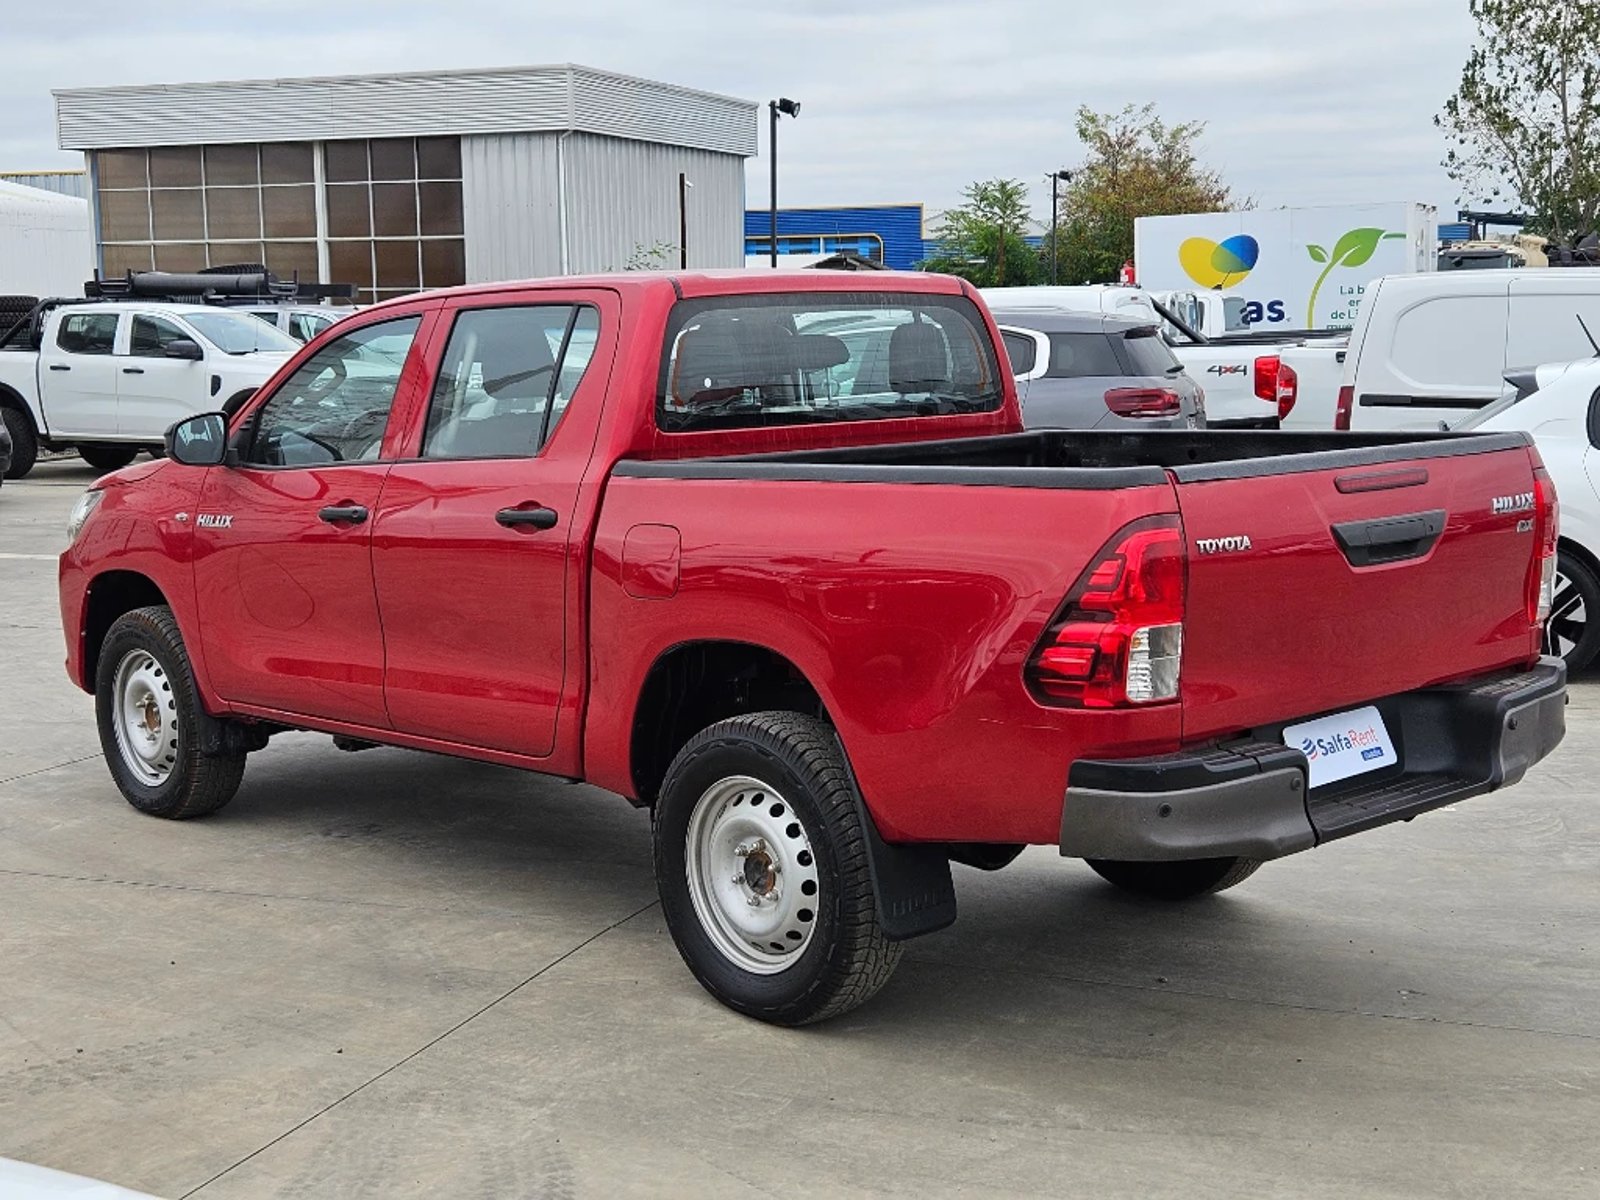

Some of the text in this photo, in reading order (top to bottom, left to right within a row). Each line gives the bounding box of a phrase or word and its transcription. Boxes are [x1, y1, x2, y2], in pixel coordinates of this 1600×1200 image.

[1340, 285, 1354, 295] La
[1331, 310, 1346, 320] de
[1491, 491, 1536, 514] HILUX
[196, 513, 234, 528] HILUX
[1196, 535, 1252, 554] TOYOTA
[1317, 724, 1379, 756] SalfaRent
